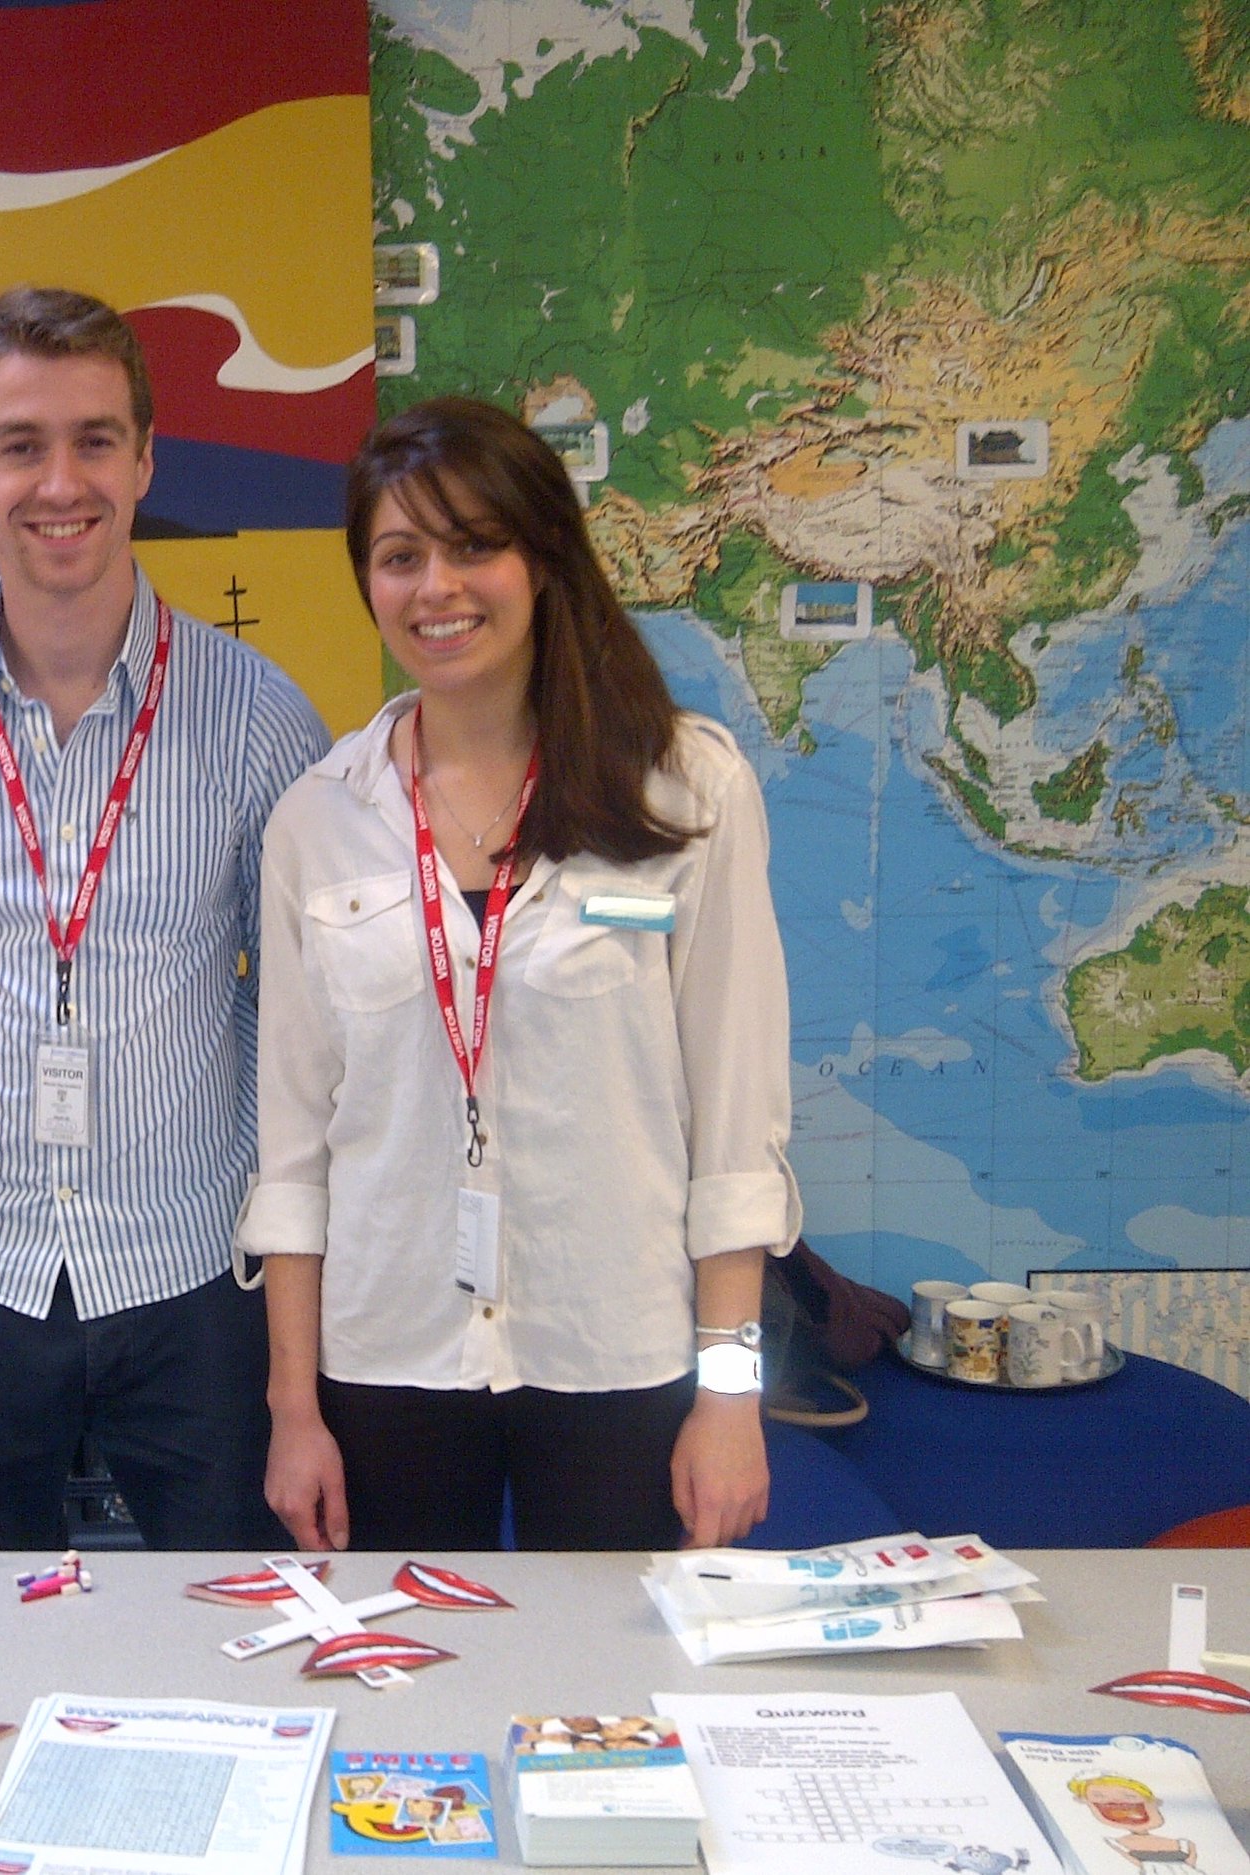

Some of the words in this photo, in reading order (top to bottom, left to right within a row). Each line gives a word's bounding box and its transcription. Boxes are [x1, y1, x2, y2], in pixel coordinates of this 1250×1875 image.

[713, 146, 827, 165] RUSSIA
[147, 663, 164, 709] VISITOR
[121, 731, 145, 780] VISITOR
[15, 802, 38, 851] VISITOR
[96, 800, 121, 849] VISITOR
[74, 870, 98, 920] VISITOR
[421, 852, 438, 903] VISITOR
[429, 926, 449, 981] VISITOR
[480, 913, 500, 968] VISITOR
[443, 1005, 466, 1059] VISITOR
[473, 993, 487, 1048] VISITOR
[42, 1066, 84, 1080] VISITOR
[818, 1058, 990, 1078] OCEAN
[65, 1704, 269, 1729] WORDSEARCH
[755, 1708, 867, 1719] Quizword
[345, 1752, 472, 1767] SMILE
